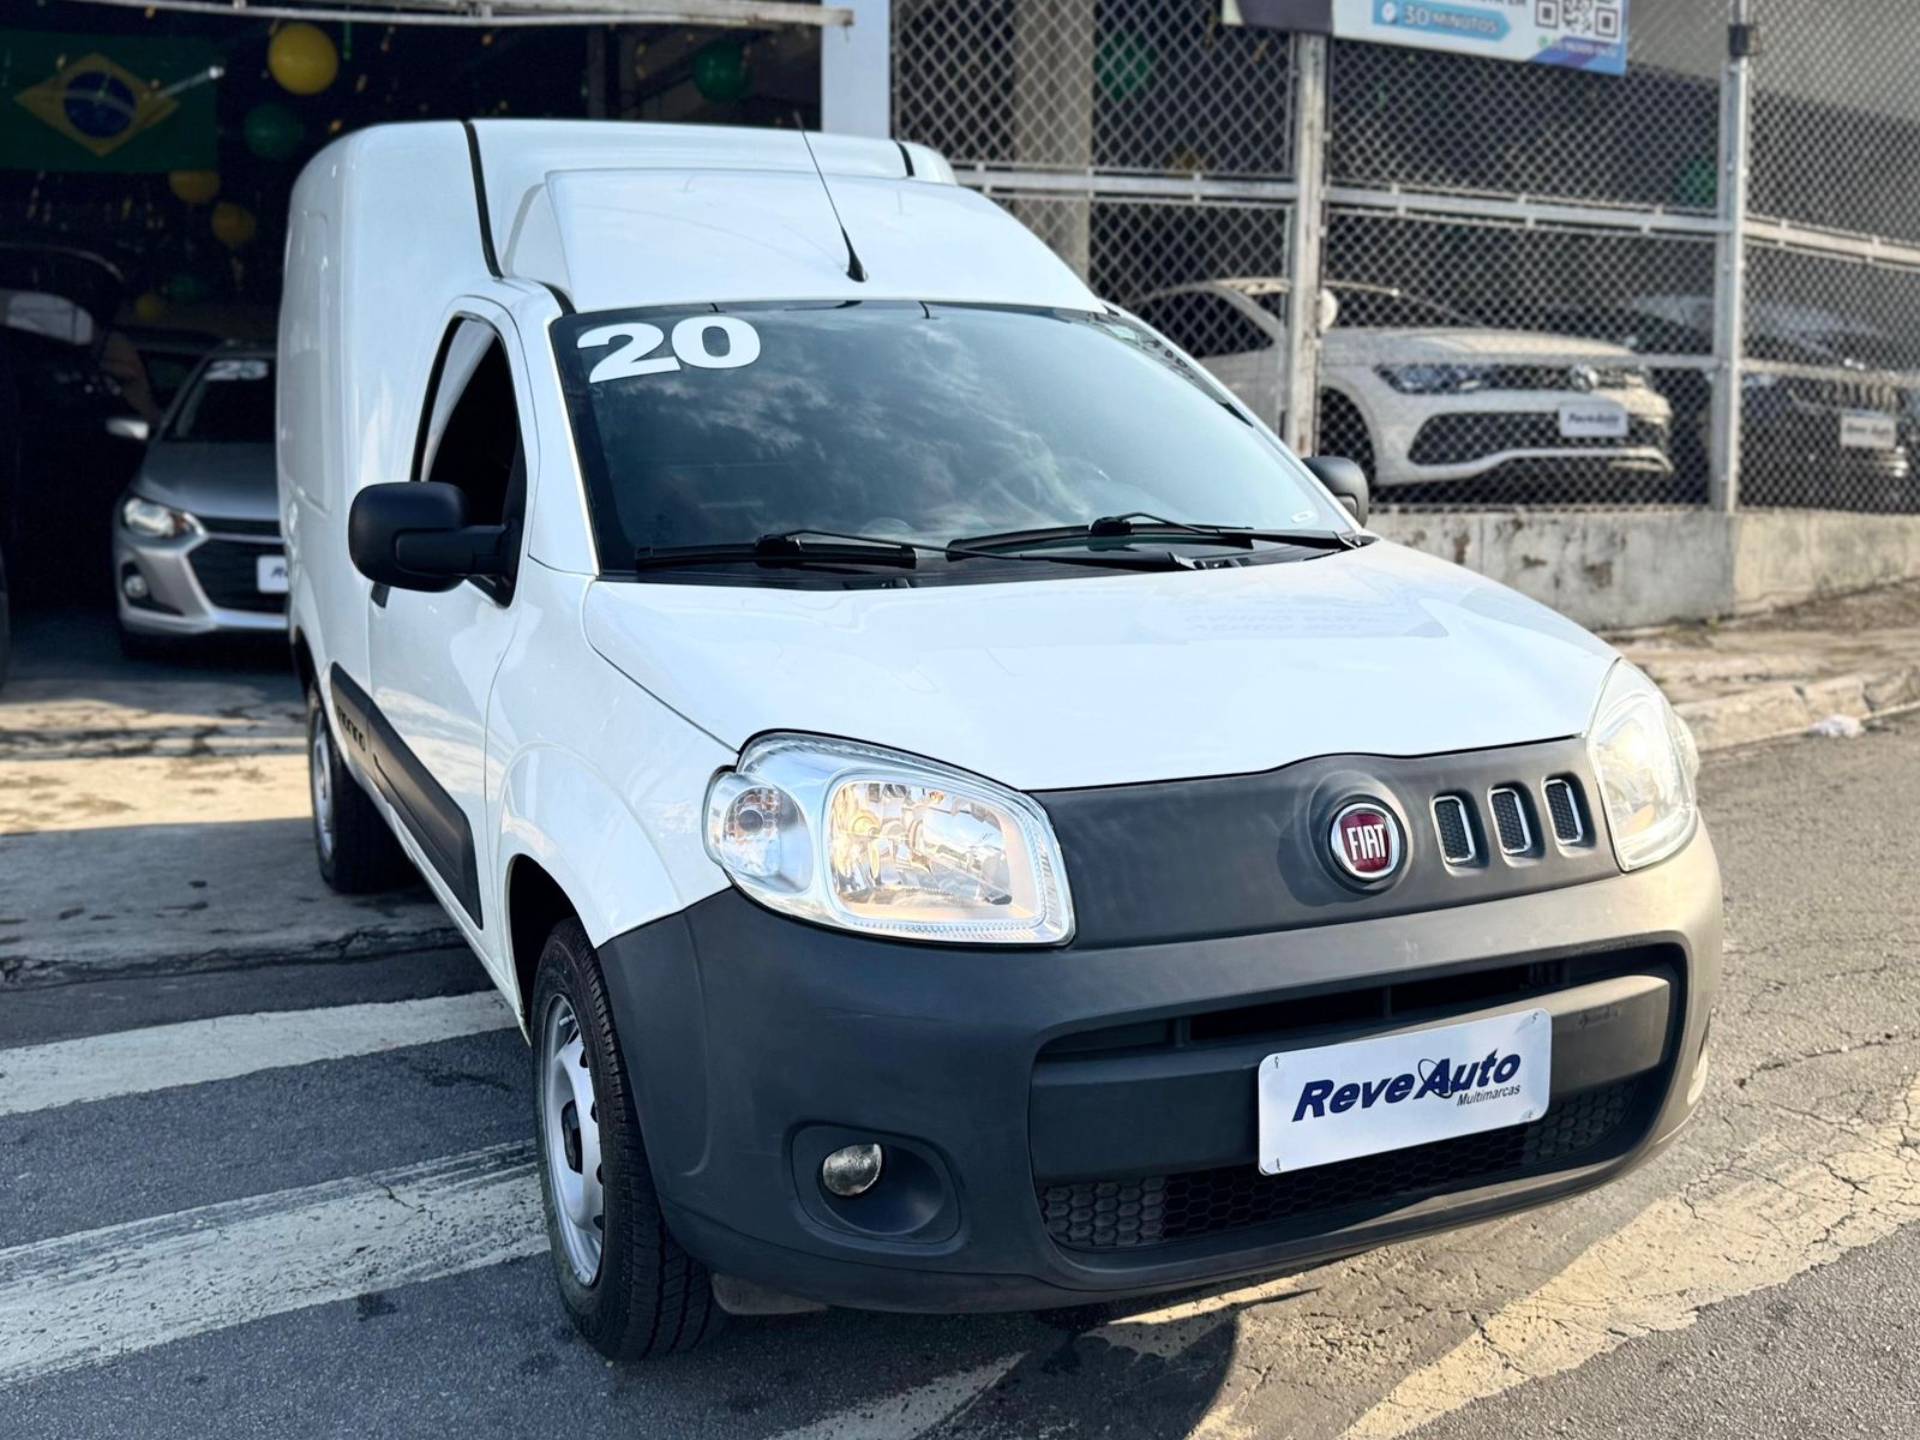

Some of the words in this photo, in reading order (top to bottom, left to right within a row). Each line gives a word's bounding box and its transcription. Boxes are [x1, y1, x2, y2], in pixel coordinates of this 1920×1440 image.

[1405, 6, 1429, 25] 30
[577, 316, 761, 384] 20
[1346, 823, 1386, 861] FIAT
[1456, 1084, 1521, 1107] Multimarcas
